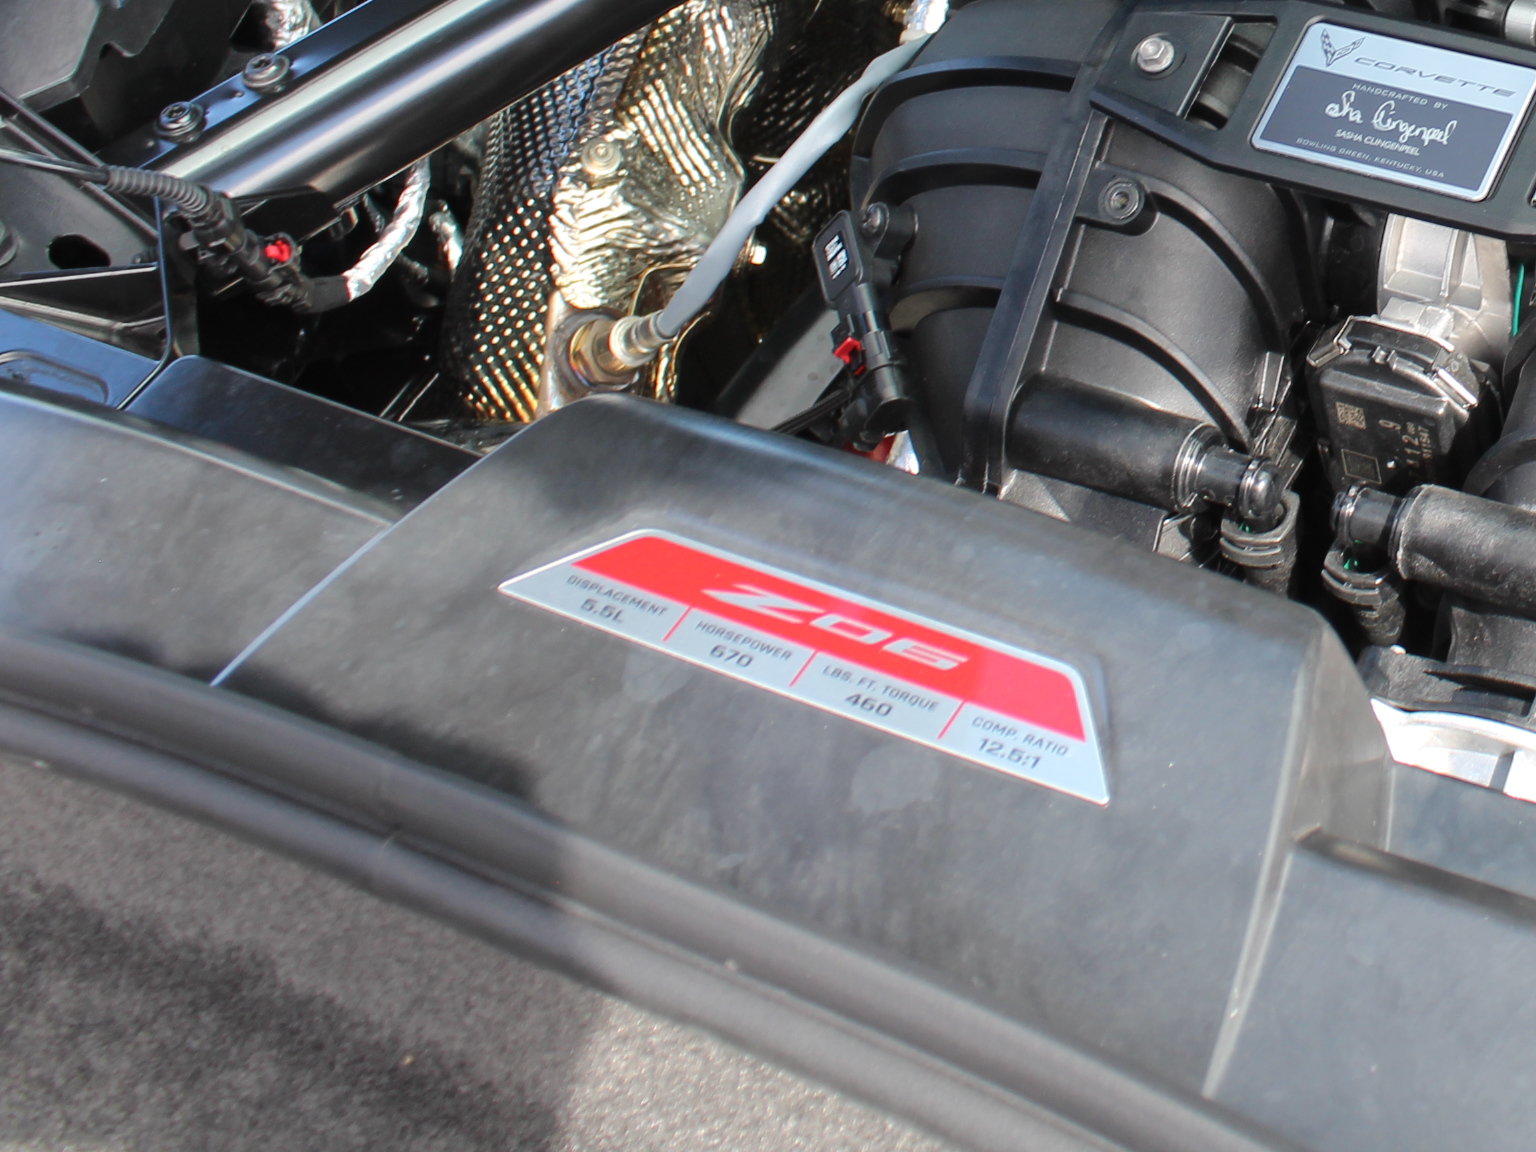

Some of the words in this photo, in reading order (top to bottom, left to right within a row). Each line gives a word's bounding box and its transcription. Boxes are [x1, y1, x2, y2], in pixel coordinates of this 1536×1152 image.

[1352, 83, 1428, 106] HANDCRAFTED
[1433, 101, 1448, 110] BY
[1354, 56, 1517, 98] CORVETTE
[1296, 137, 1337, 153] BOWLING
[1425, 168, 1445, 179] USA
[1335, 128, 1363, 142] SASHA
[1363, 135, 1421, 157] CLINGENPEEL
[566, 574, 669, 617] DISPLACEMENT
[695, 620, 793, 662] HORSEPOWER
[701, 583, 969, 671] Z06
[709, 644, 754, 669] 670
[823, 664, 854, 684] LBS.
[857, 675, 877, 692] FT.
[882, 683, 940, 713] TORQUE
[844, 692, 893, 718] 460
[971, 715, 1019, 742] COMP.
[1023, 733, 1069, 757] RATIO
